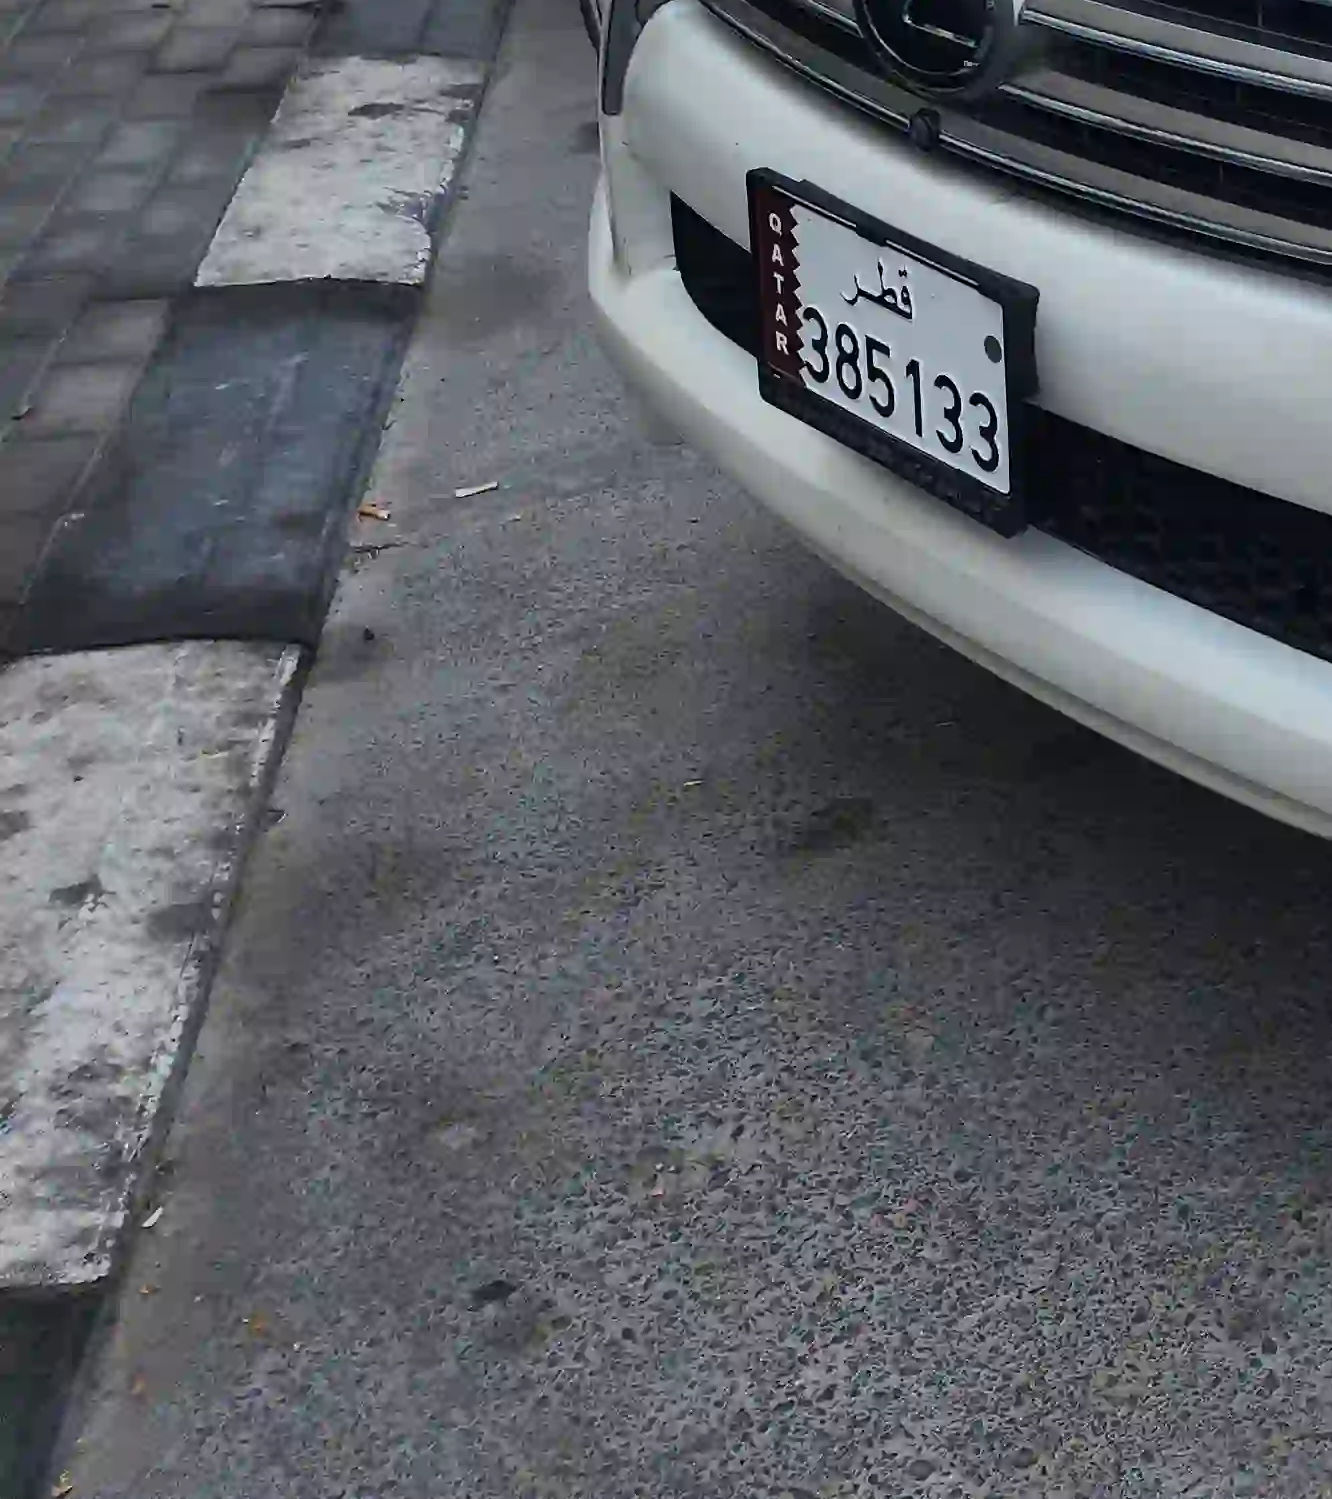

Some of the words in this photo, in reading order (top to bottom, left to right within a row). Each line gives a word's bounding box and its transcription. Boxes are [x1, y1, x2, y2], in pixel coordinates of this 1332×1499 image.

[768, 212, 790, 356] QATAR
[840, 257, 913, 321] قطر
[803, 306, 1000, 473] 385133
